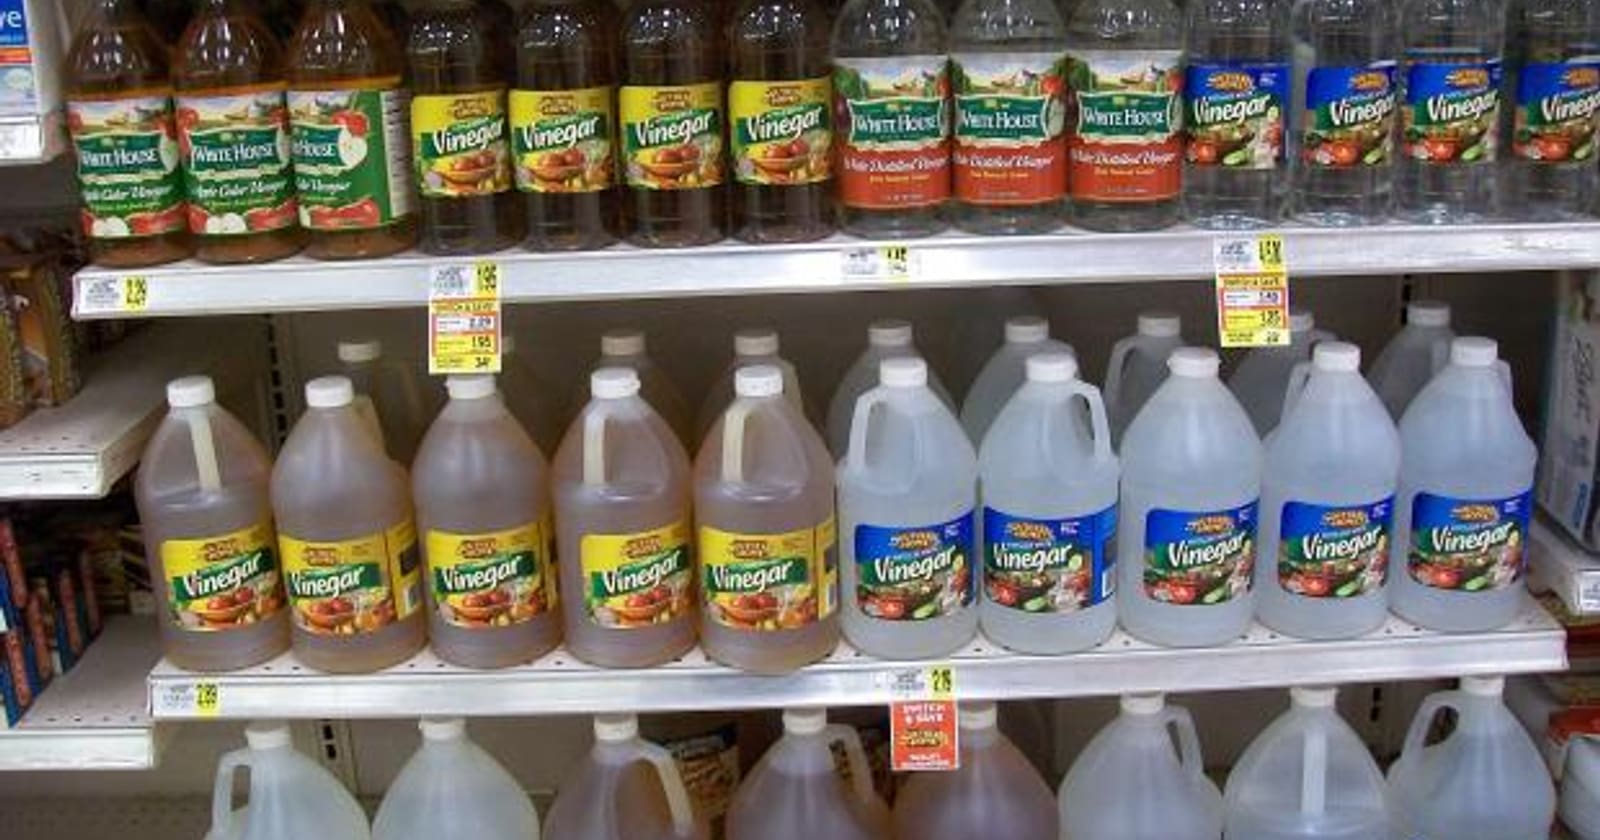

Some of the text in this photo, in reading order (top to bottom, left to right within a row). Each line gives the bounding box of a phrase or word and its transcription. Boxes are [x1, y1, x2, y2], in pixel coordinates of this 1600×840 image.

[995, 112, 1038, 130] HOUSE
[1083, 107, 1165, 127] WHITE HOUSE
[1194, 93, 1271, 124] Vinegar
[1330, 93, 1396, 126] Vinegar
[1427, 89, 1498, 121] Vinegar
[433, 116, 505, 155] Vinegar
[523, 115, 600, 151] Vinegar
[635, 110, 714, 147] Vinegar
[746, 104, 823, 142] Vinegar
[114, 148, 158, 167] HOUSE
[194, 142, 275, 164] WHITE HOUSE
[1168, 531, 1246, 568] Vinegar
[1302, 525, 1383, 560] Vinegar
[1431, 521, 1515, 552] Vinegar
[440, 554, 523, 591] Vinegar
[602, 549, 682, 595] Vinegar
[875, 544, 957, 582] Vinegar
[992, 541, 1073, 573] Vinegar
[182, 551, 263, 598] Vinegar
[290, 565, 366, 598] Vinegar
[711, 560, 794, 593] Vinegar
